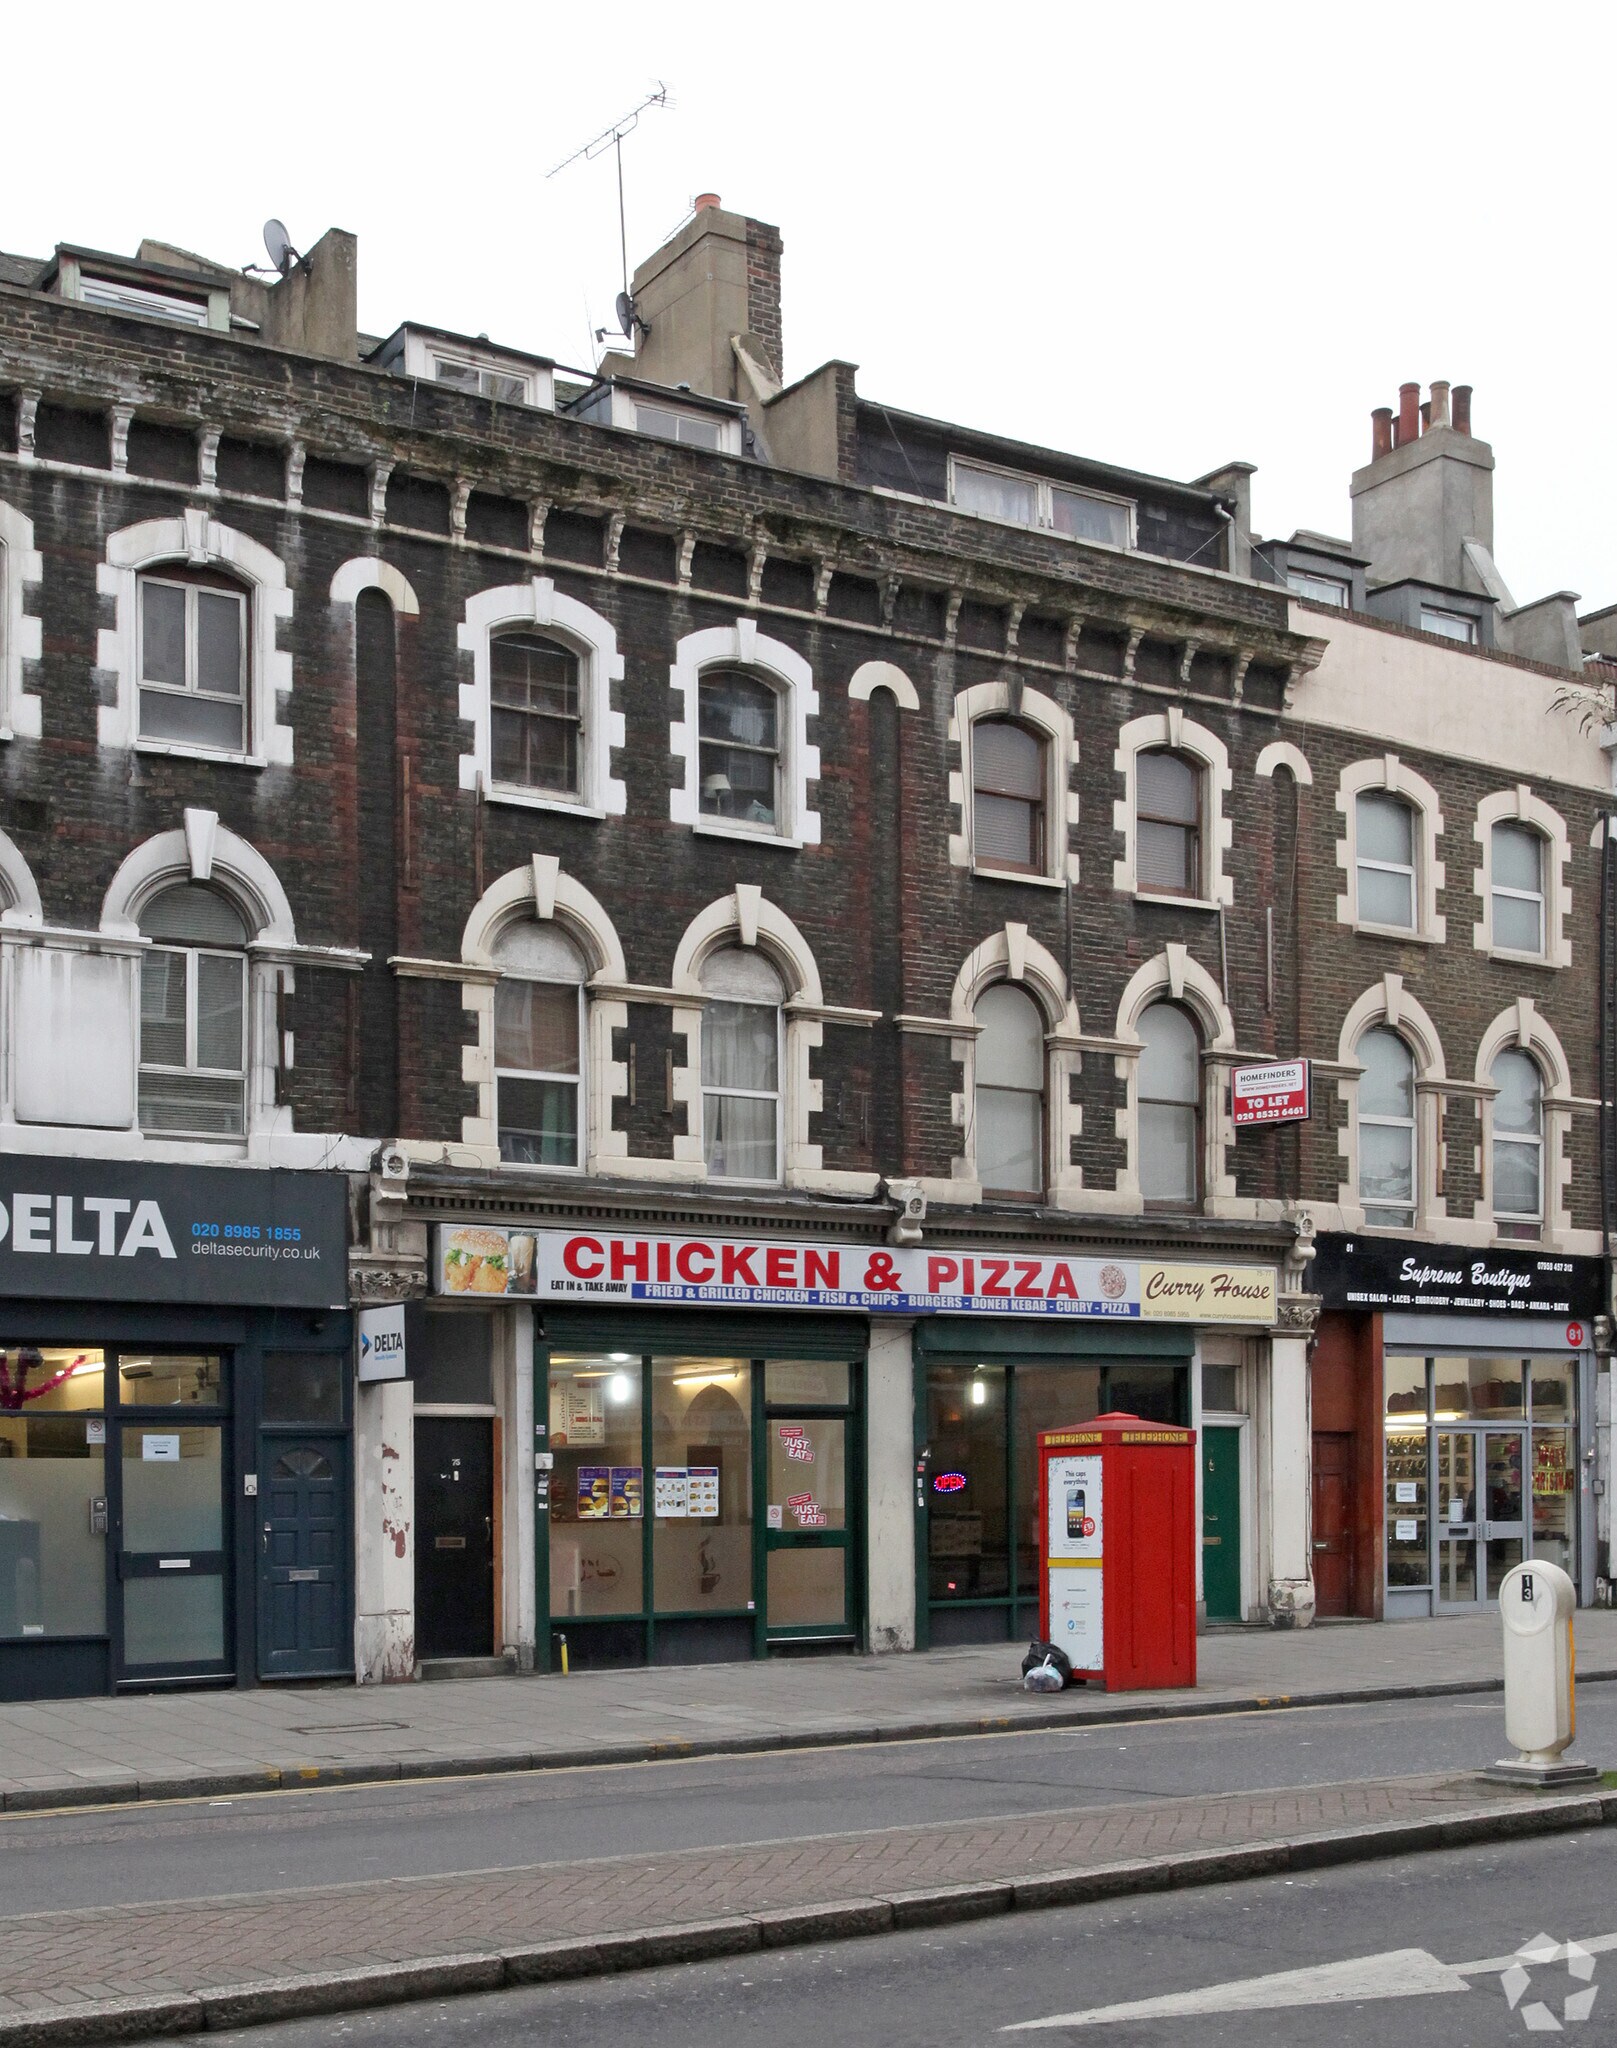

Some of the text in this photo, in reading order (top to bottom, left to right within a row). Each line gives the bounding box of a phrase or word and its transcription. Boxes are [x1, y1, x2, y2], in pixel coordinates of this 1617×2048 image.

[1240, 1069, 1296, 1082] HOMEFINDERS
[1247, 1095, 1289, 1109] TO LET
[1236, 1106, 1304, 1121] 020 8533 6461
[0, 1193, 177, 1259] ELTA
[191, 1223, 301, 1241] 020 8985 1855
[191, 1241, 320, 1261] deltasecurity.co.uk
[1346, 1243, 1353, 1252] 81
[563, 1237, 1079, 1299] CHICKEN & PIZZA
[1399, 1257, 1531, 1295] Supreme Boutique
[551, 1280, 628, 1293] EAT IN & TAKE AWAY
[1146, 1271, 1270, 1302] Curry House
[645, 1284, 683, 1298] FRIED
[685, 1287, 696, 1299] &
[698, 1286, 750, 1300] GRILLED
[753, 1288, 809, 1303] CHICKEN
[819, 1291, 847, 1304] FISH
[849, 1294, 859, 1305] &
[861, 1293, 899, 1306] CHIPS
[908, 1295, 962, 1308] BURGERS
[971, 1297, 1009, 1310] DONER
[1011, 1299, 1047, 1311] KEBAB
[1056, 1301, 1093, 1313] CURRY
[1101, 1303, 1130, 1314] PIZZA
[1347, 1292, 1569, 1311] UNISEX SALON LACES EMBROIDERY JEWELLERY SHOES BAGS ANKARA BATIK
[1568, 1329, 1582, 1341] 81
[374, 1332, 403, 1352] DELTA
[784, 1437, 809, 1450] JUST
[1050, 1433, 1098, 1444] TELEPHONE
[1128, 1432, 1183, 1442] TELEPHONE
[788, 1448, 807, 1460] EAT
[1076, 1471, 1086, 1479] caps
[936, 1476, 964, 1489] OPEN
[794, 1504, 819, 1515] JUST
[800, 1515, 818, 1524] EAT
